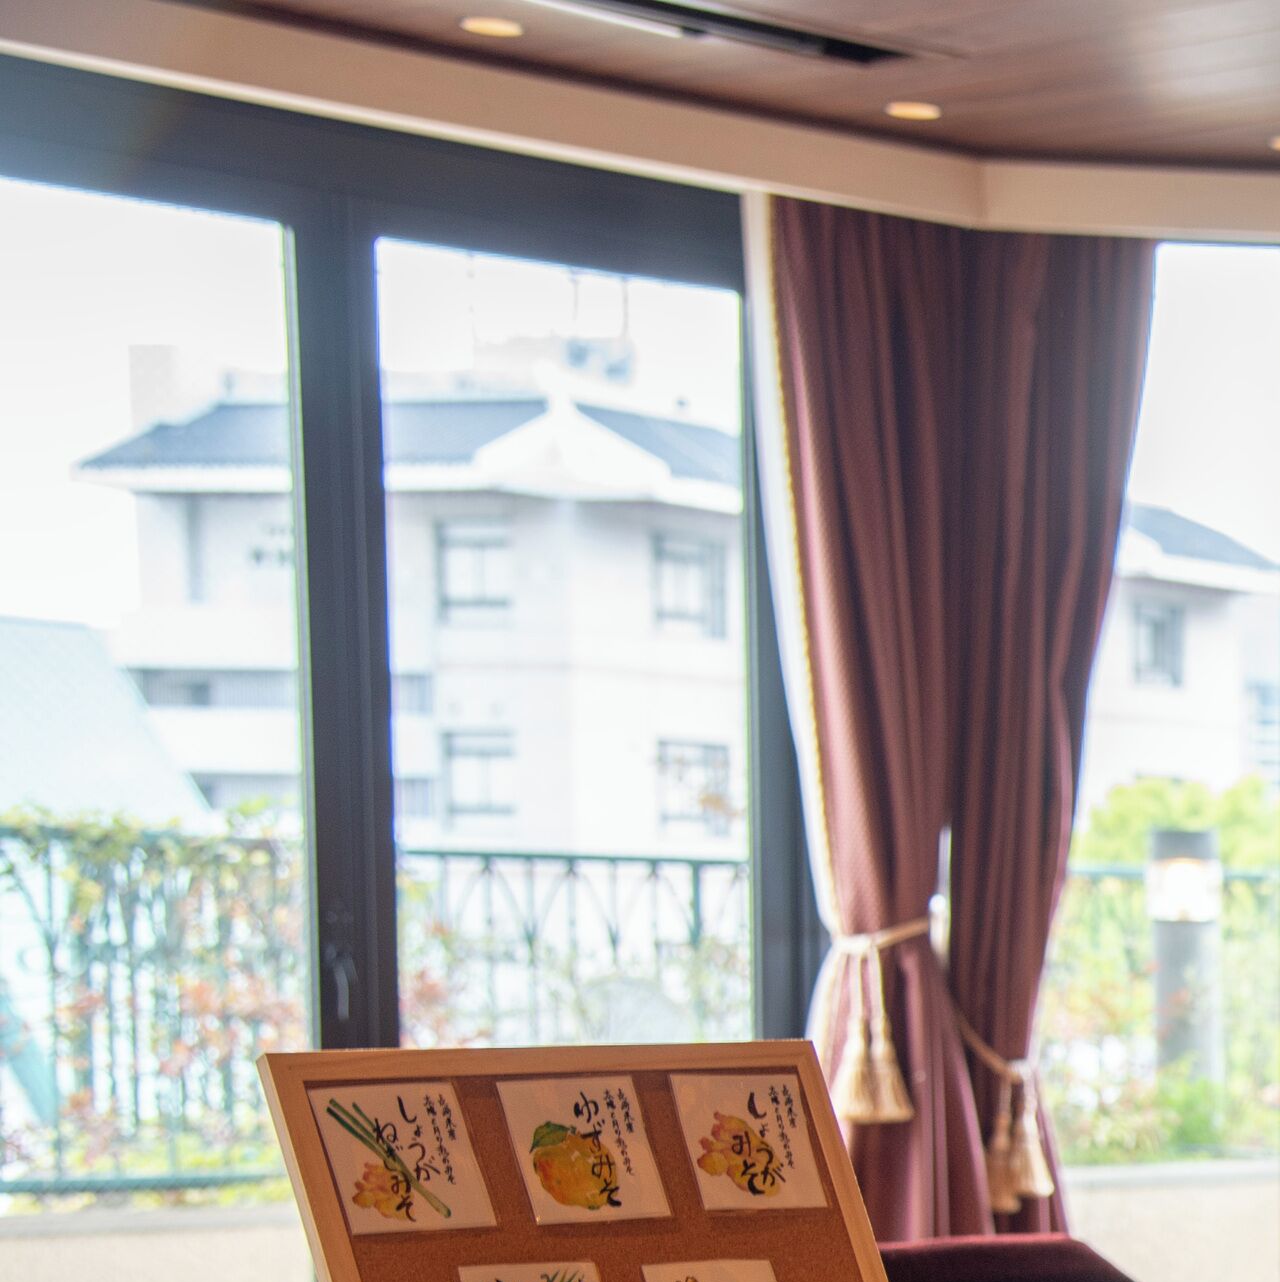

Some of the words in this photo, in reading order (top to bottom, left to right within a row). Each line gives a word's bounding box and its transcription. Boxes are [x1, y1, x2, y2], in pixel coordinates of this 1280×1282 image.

[373, 1117, 417, 1222] ねぎみそ
[397, 1095, 441, 1182] しょうが
[573, 1091, 623, 1207] ゆずみそ
[731, 1130, 766, 1196] みそ
[747, 1091, 787, 1186] しょうが
